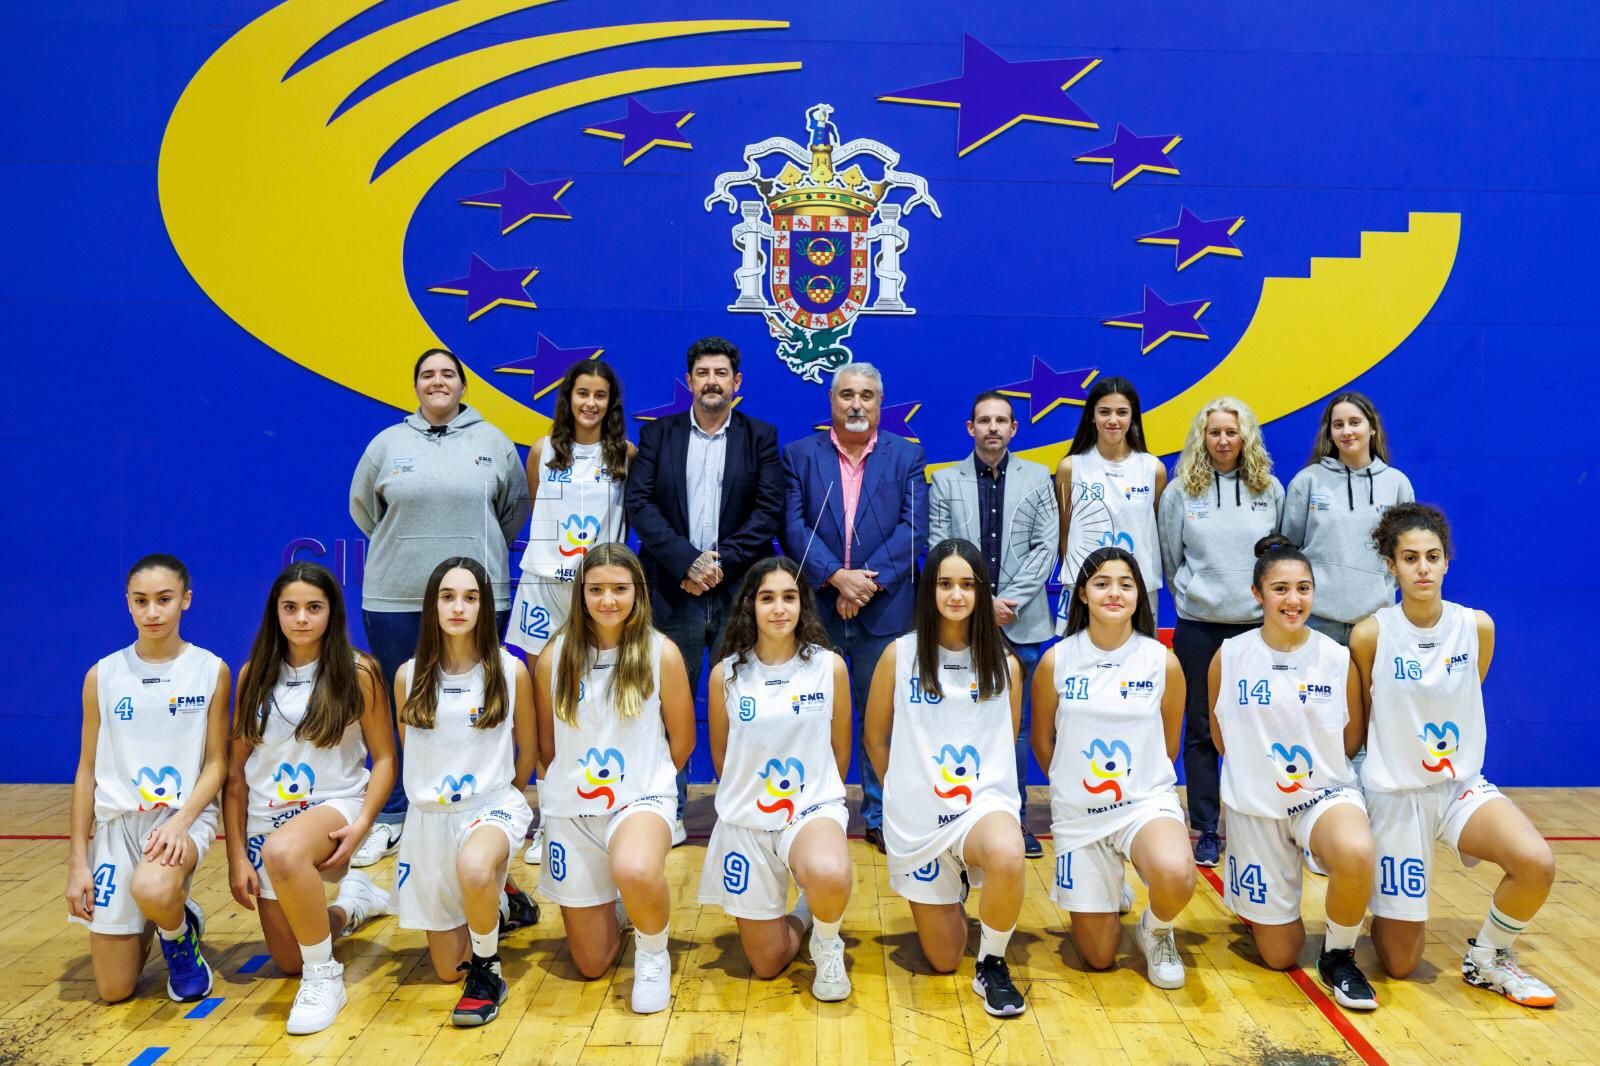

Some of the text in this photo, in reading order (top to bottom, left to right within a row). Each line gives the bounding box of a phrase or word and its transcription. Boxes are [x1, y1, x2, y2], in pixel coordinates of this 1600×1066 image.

[519, 600, 551, 640] 12
[1058, 589, 1071, 620] 1
[1394, 656, 1423, 681] 16
[1065, 677, 1090, 700] 11
[1238, 679, 1272, 705] 14
[114, 696, 134, 721] 4
[738, 695, 757, 722] 9
[549, 840, 567, 882] 8
[723, 851, 750, 895] 9
[1380, 855, 1426, 898] 16
[93, 862, 117, 908] 4
[1229, 855, 1267, 904] 14
